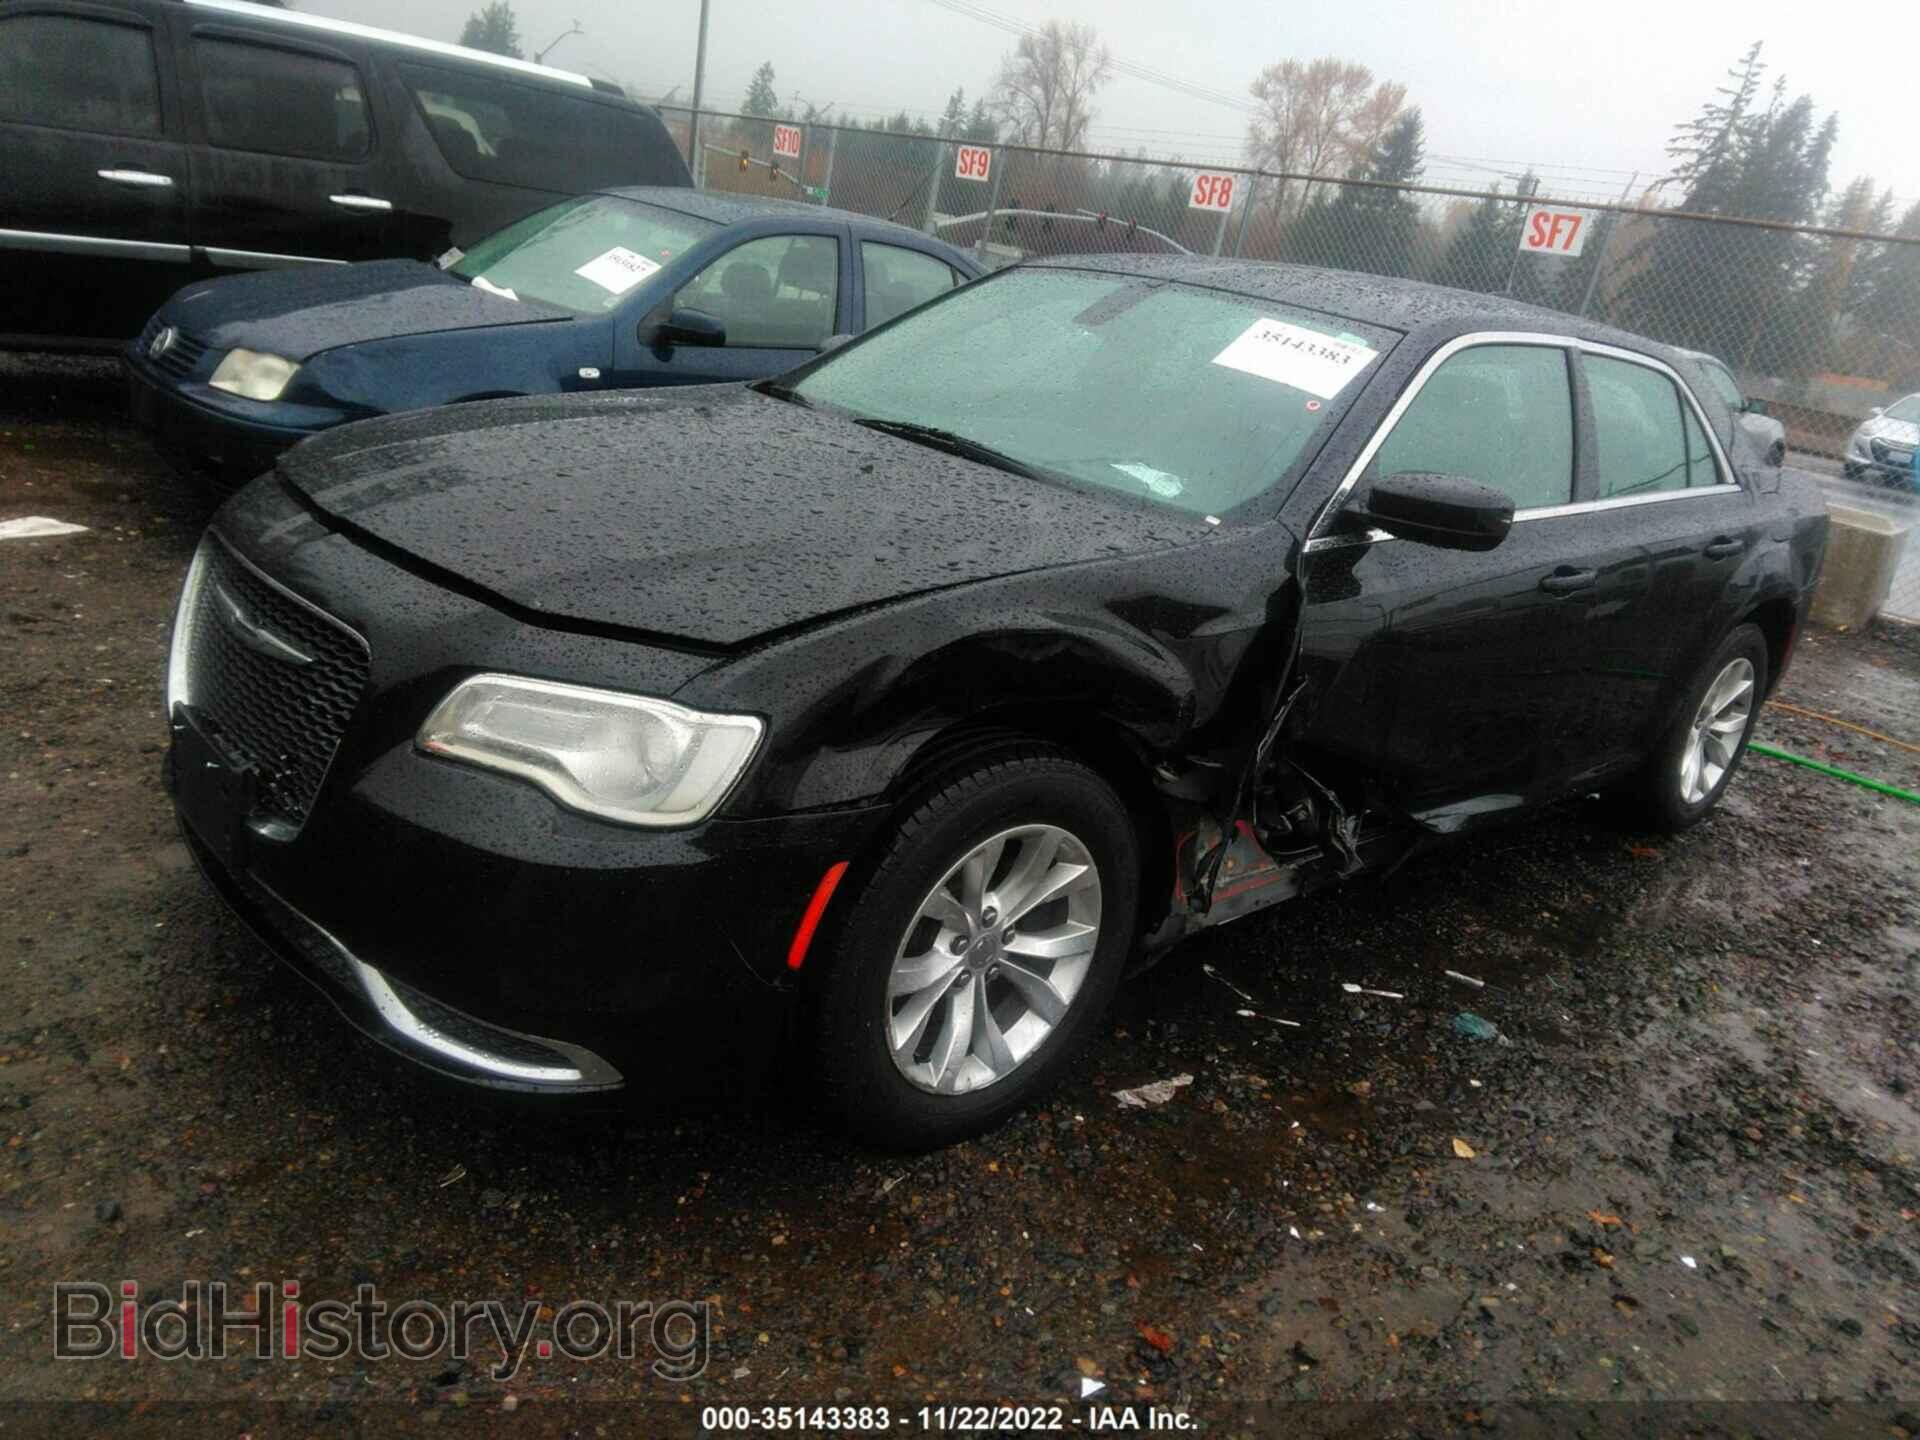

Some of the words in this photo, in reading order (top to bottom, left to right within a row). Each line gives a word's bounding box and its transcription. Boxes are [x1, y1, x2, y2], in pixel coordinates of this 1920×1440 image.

[774, 127, 800, 154] SF10
[959, 149, 988, 177] SF9
[1194, 175, 1233, 208] SF8
[1528, 211, 1583, 251] SF7
